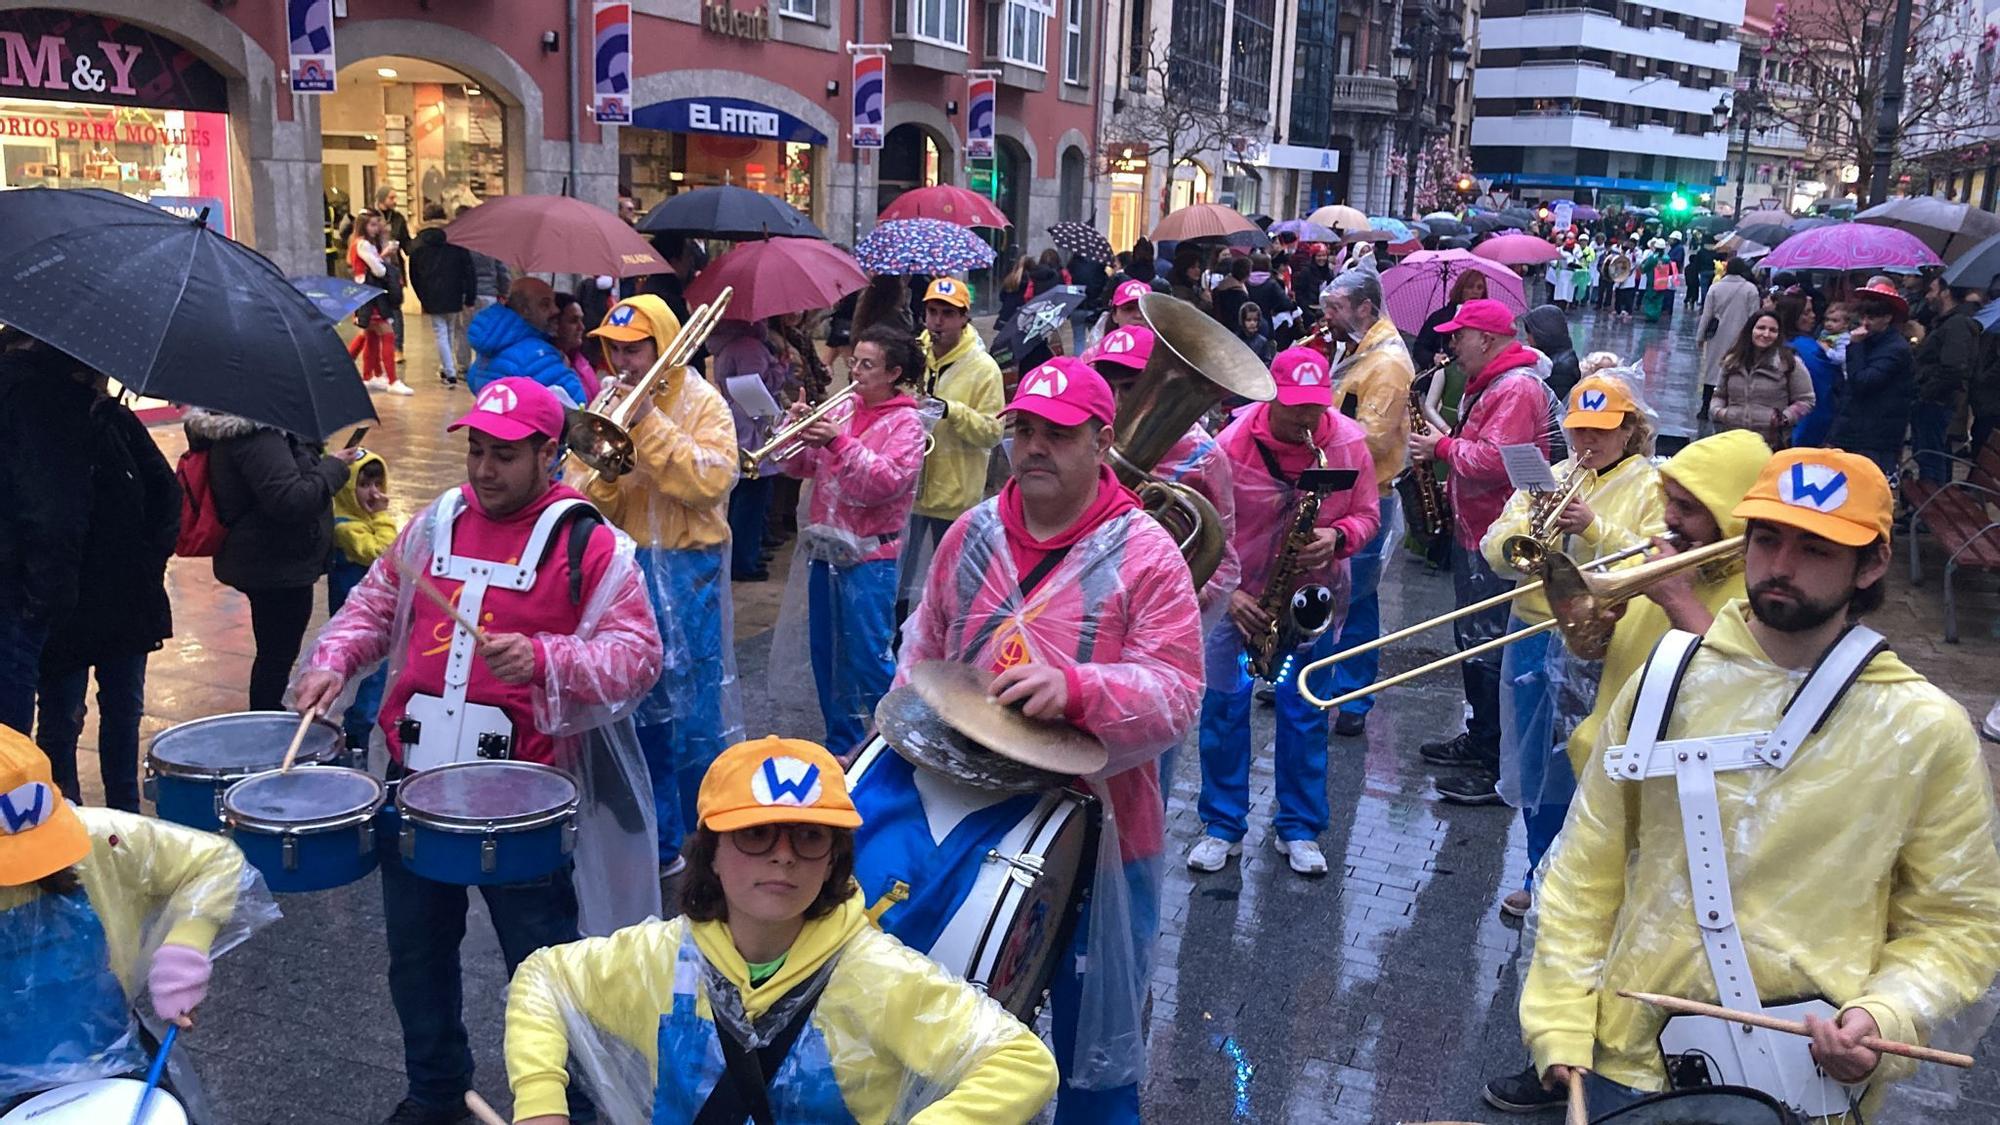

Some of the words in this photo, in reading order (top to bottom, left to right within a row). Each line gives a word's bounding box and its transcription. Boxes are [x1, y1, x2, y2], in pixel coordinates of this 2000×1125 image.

[0, 31, 143, 95] M&Y
[67, 120, 119, 141] PARA
[689, 103, 720, 131] EL
[720, 106, 779, 137] ATRIO
[938, 281, 953, 294] W
[1127, 285, 1145, 298] M
[611, 307, 636, 327] W
[1105, 333, 1128, 354] M
[1024, 367, 1059, 397] M
[1297, 363, 1321, 385] M
[478, 386, 510, 414] M
[1582, 390, 1606, 410] W
[1791, 462, 1848, 507] W
[762, 756, 820, 803] W
[0, 793, 45, 833] W
